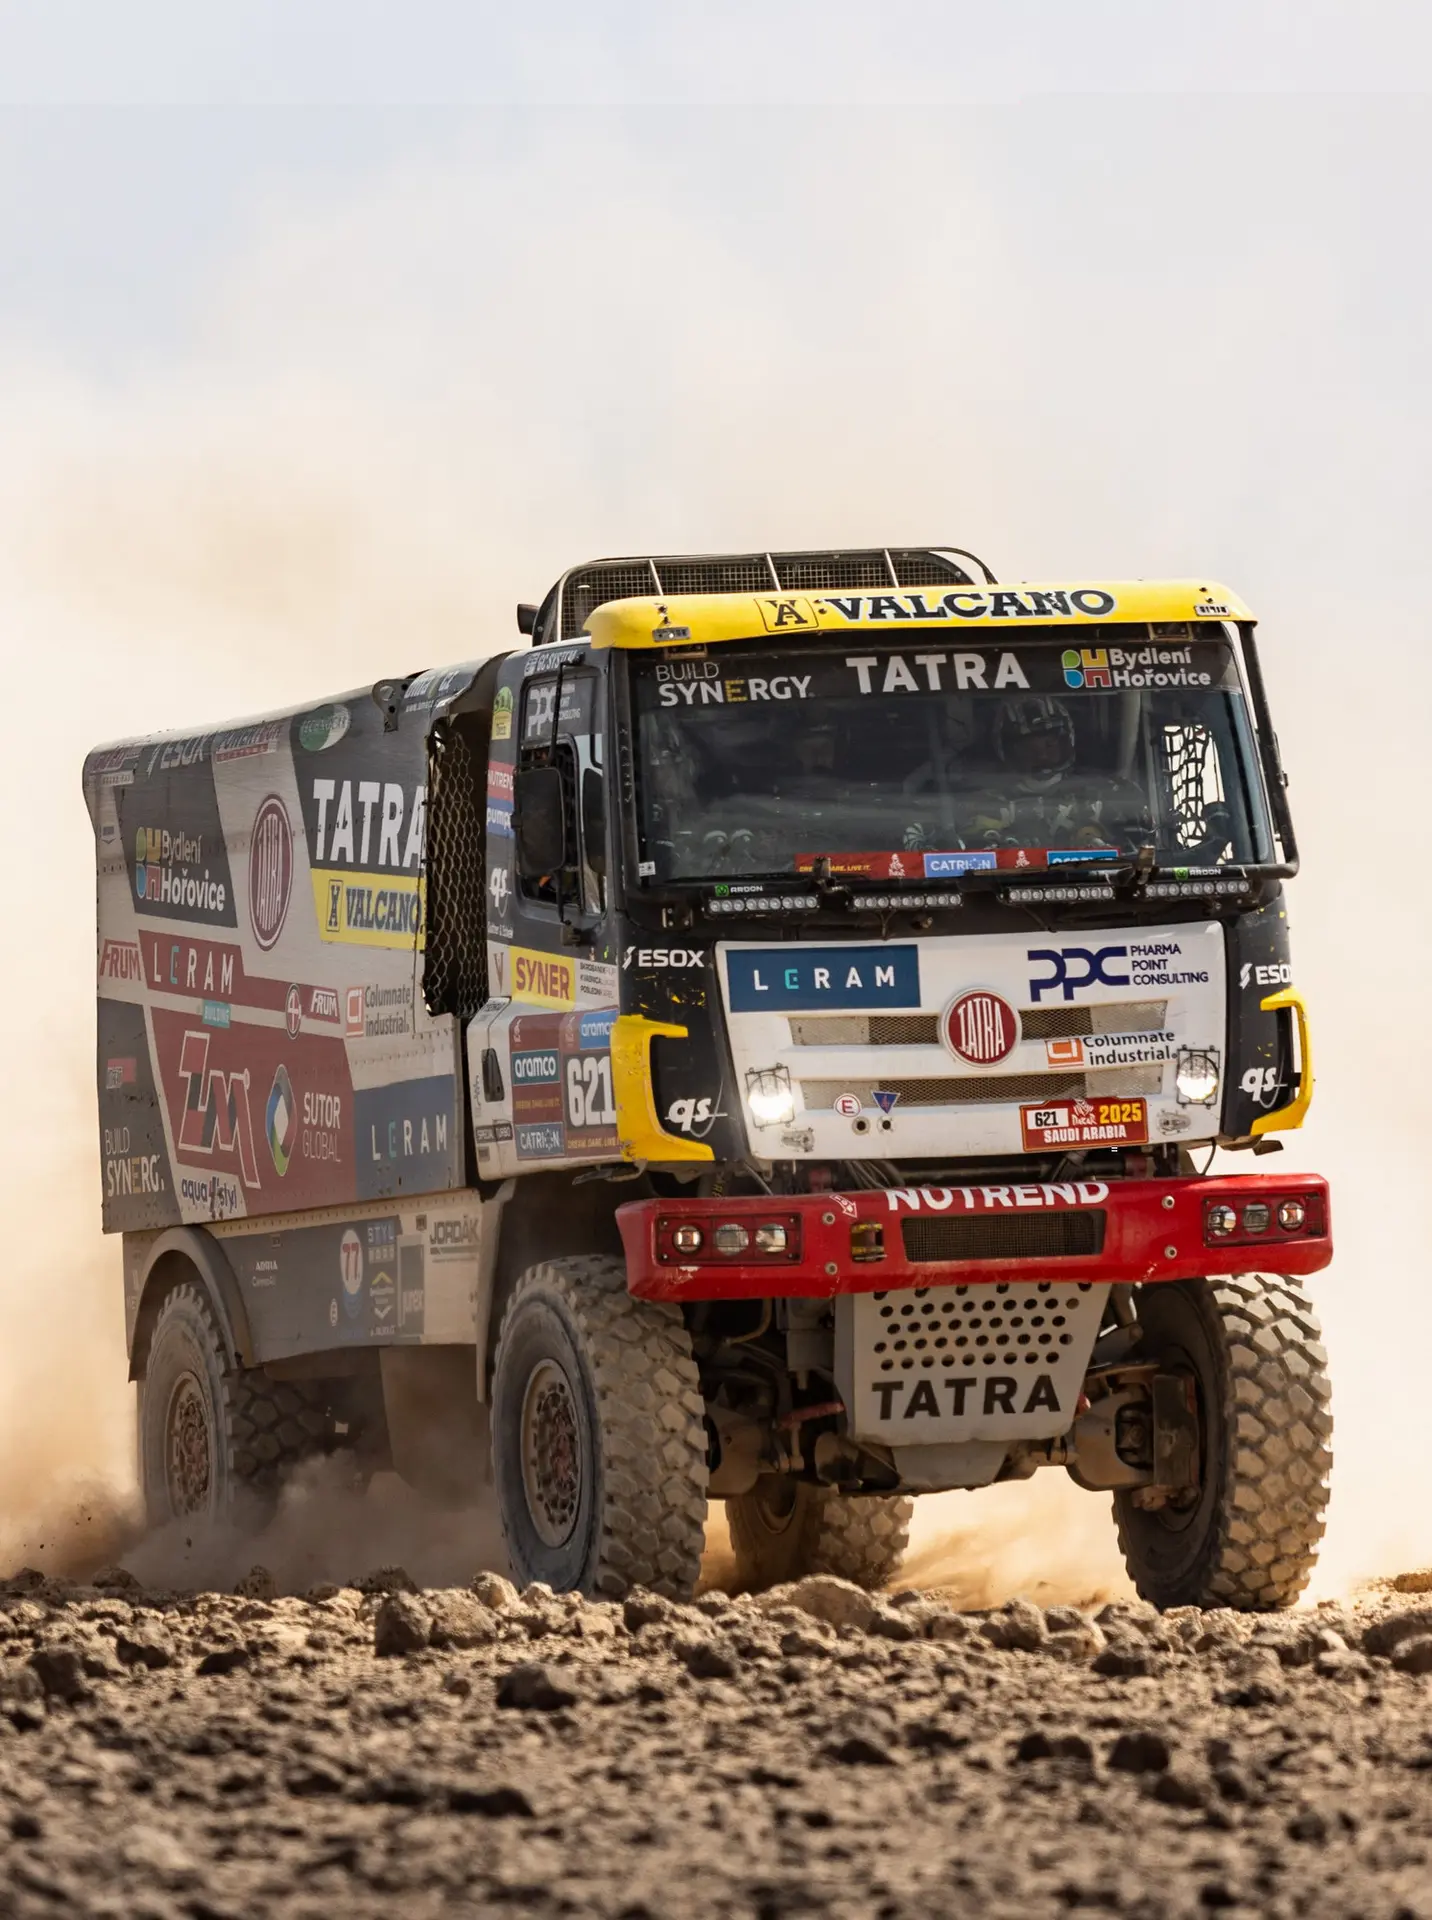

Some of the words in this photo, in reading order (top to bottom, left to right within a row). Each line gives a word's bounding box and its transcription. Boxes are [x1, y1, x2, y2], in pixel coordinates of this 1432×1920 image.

[825, 589, 1115, 621] VALCANO
[655, 661, 720, 682] BUILD
[846, 652, 1031, 694] TATRA
[1110, 646, 1192, 672] Bydlení
[658, 675, 812, 707] SYNERGY
[1113, 668, 1212, 689] Hořovice
[313, 778, 427, 870] TATRA
[161, 829, 202, 867] Bydlení
[930, 857, 991, 871] CATRION
[161, 867, 225, 912] Hořovice
[346, 887, 423, 933] VALCANO
[638, 949, 705, 968] ESOX
[1130, 943, 1181, 956] PHARMA
[1131, 959, 1168, 971] POINT
[153, 942, 234, 995] LERAM
[515, 956, 570, 1000] SYNER
[753, 965, 896, 991] LERAM
[1027, 946, 1131, 1002] PPC
[1133, 971, 1209, 986] CONSULTING
[1255, 965, 1292, 985] ESO
[581, 1021, 611, 1037] aramc
[957, 996, 1006, 1060] TATRA
[1083, 1030, 1176, 1049] Columnate
[514, 1056, 556, 1078] aramco
[566, 1056, 617, 1128] 621
[1238, 1067, 1288, 1106] qs
[303, 1091, 341, 1130] SUTOR
[664, 1098, 728, 1135] qs
[1034, 1111, 1059, 1127] 621
[1099, 1102, 1142, 1124] 2025
[105, 1126, 131, 1156] BUILD
[302, 1129, 342, 1163] GLOBAL
[371, 1114, 448, 1161] LERAM
[1043, 1127, 1080, 1143] SAUDI
[1082, 1124, 1127, 1141] ARABIA
[885, 1182, 1110, 1211] NUTREND
[342, 1242, 361, 1281] 77
[871, 1374, 1062, 1421] TATRA
